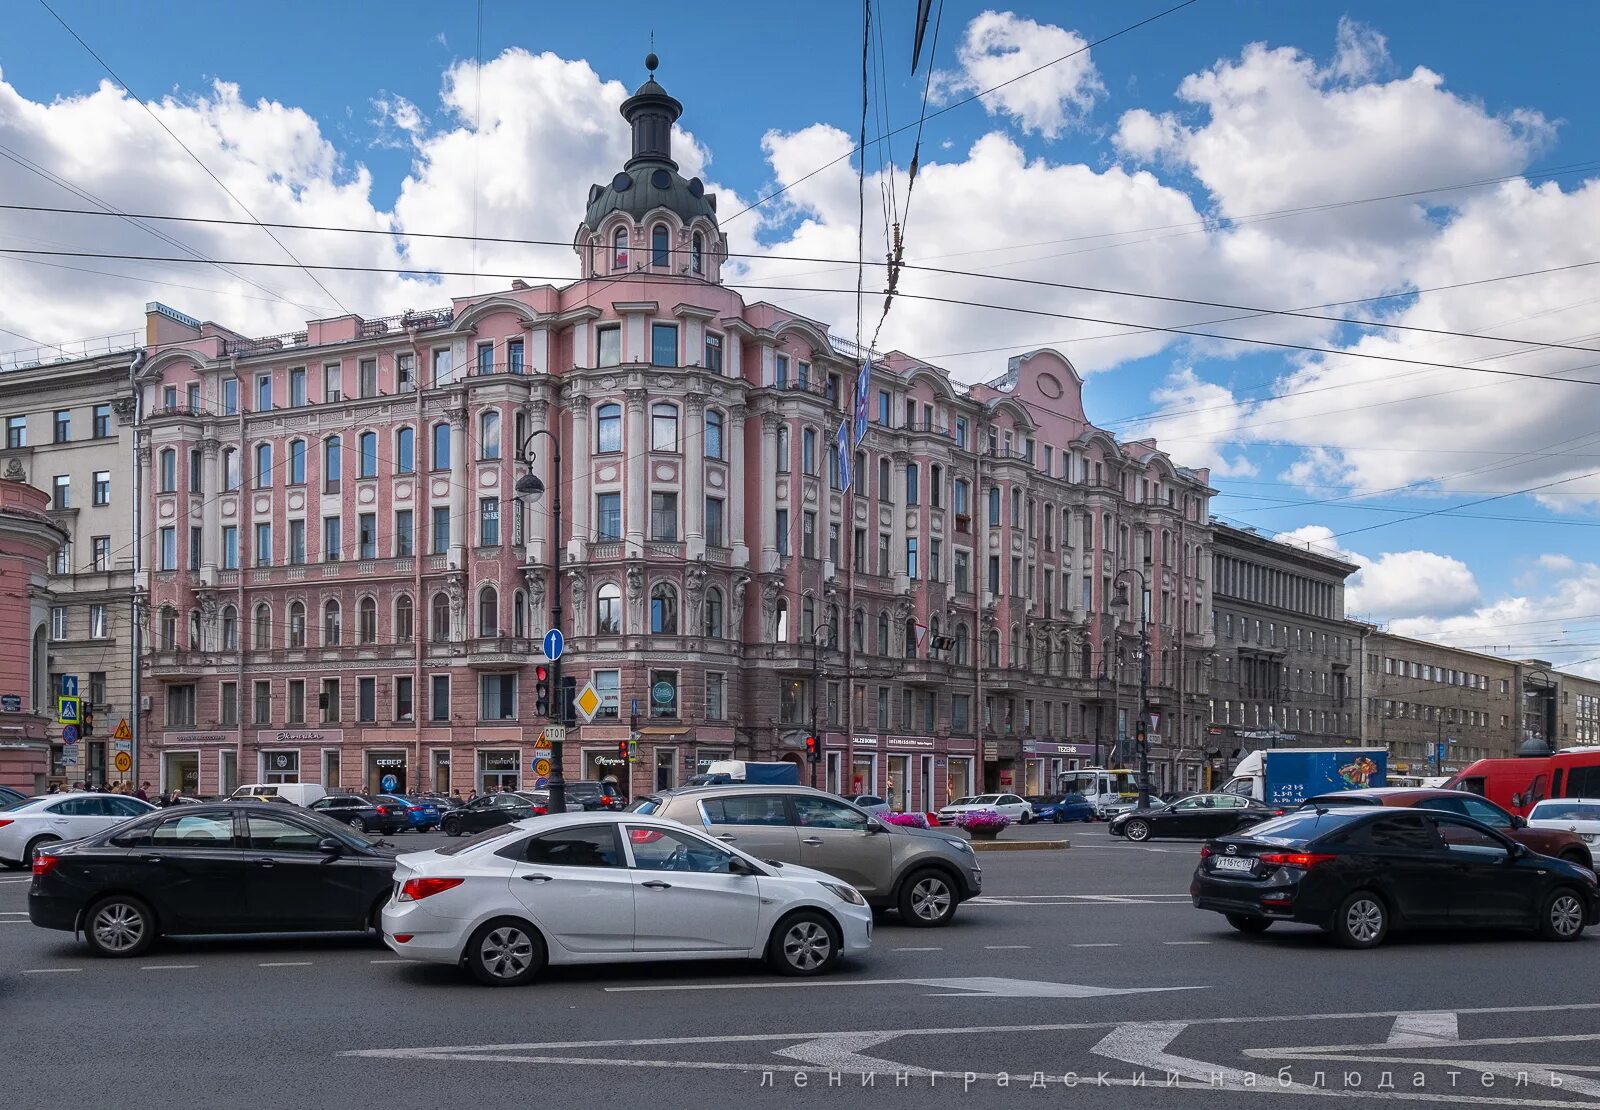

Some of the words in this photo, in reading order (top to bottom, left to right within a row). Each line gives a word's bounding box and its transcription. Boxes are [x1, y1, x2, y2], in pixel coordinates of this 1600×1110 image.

[545, 728, 565, 738] СТОП
[1057, 745, 1077, 753] TEZENIS
[118, 757, 128, 766] 40
